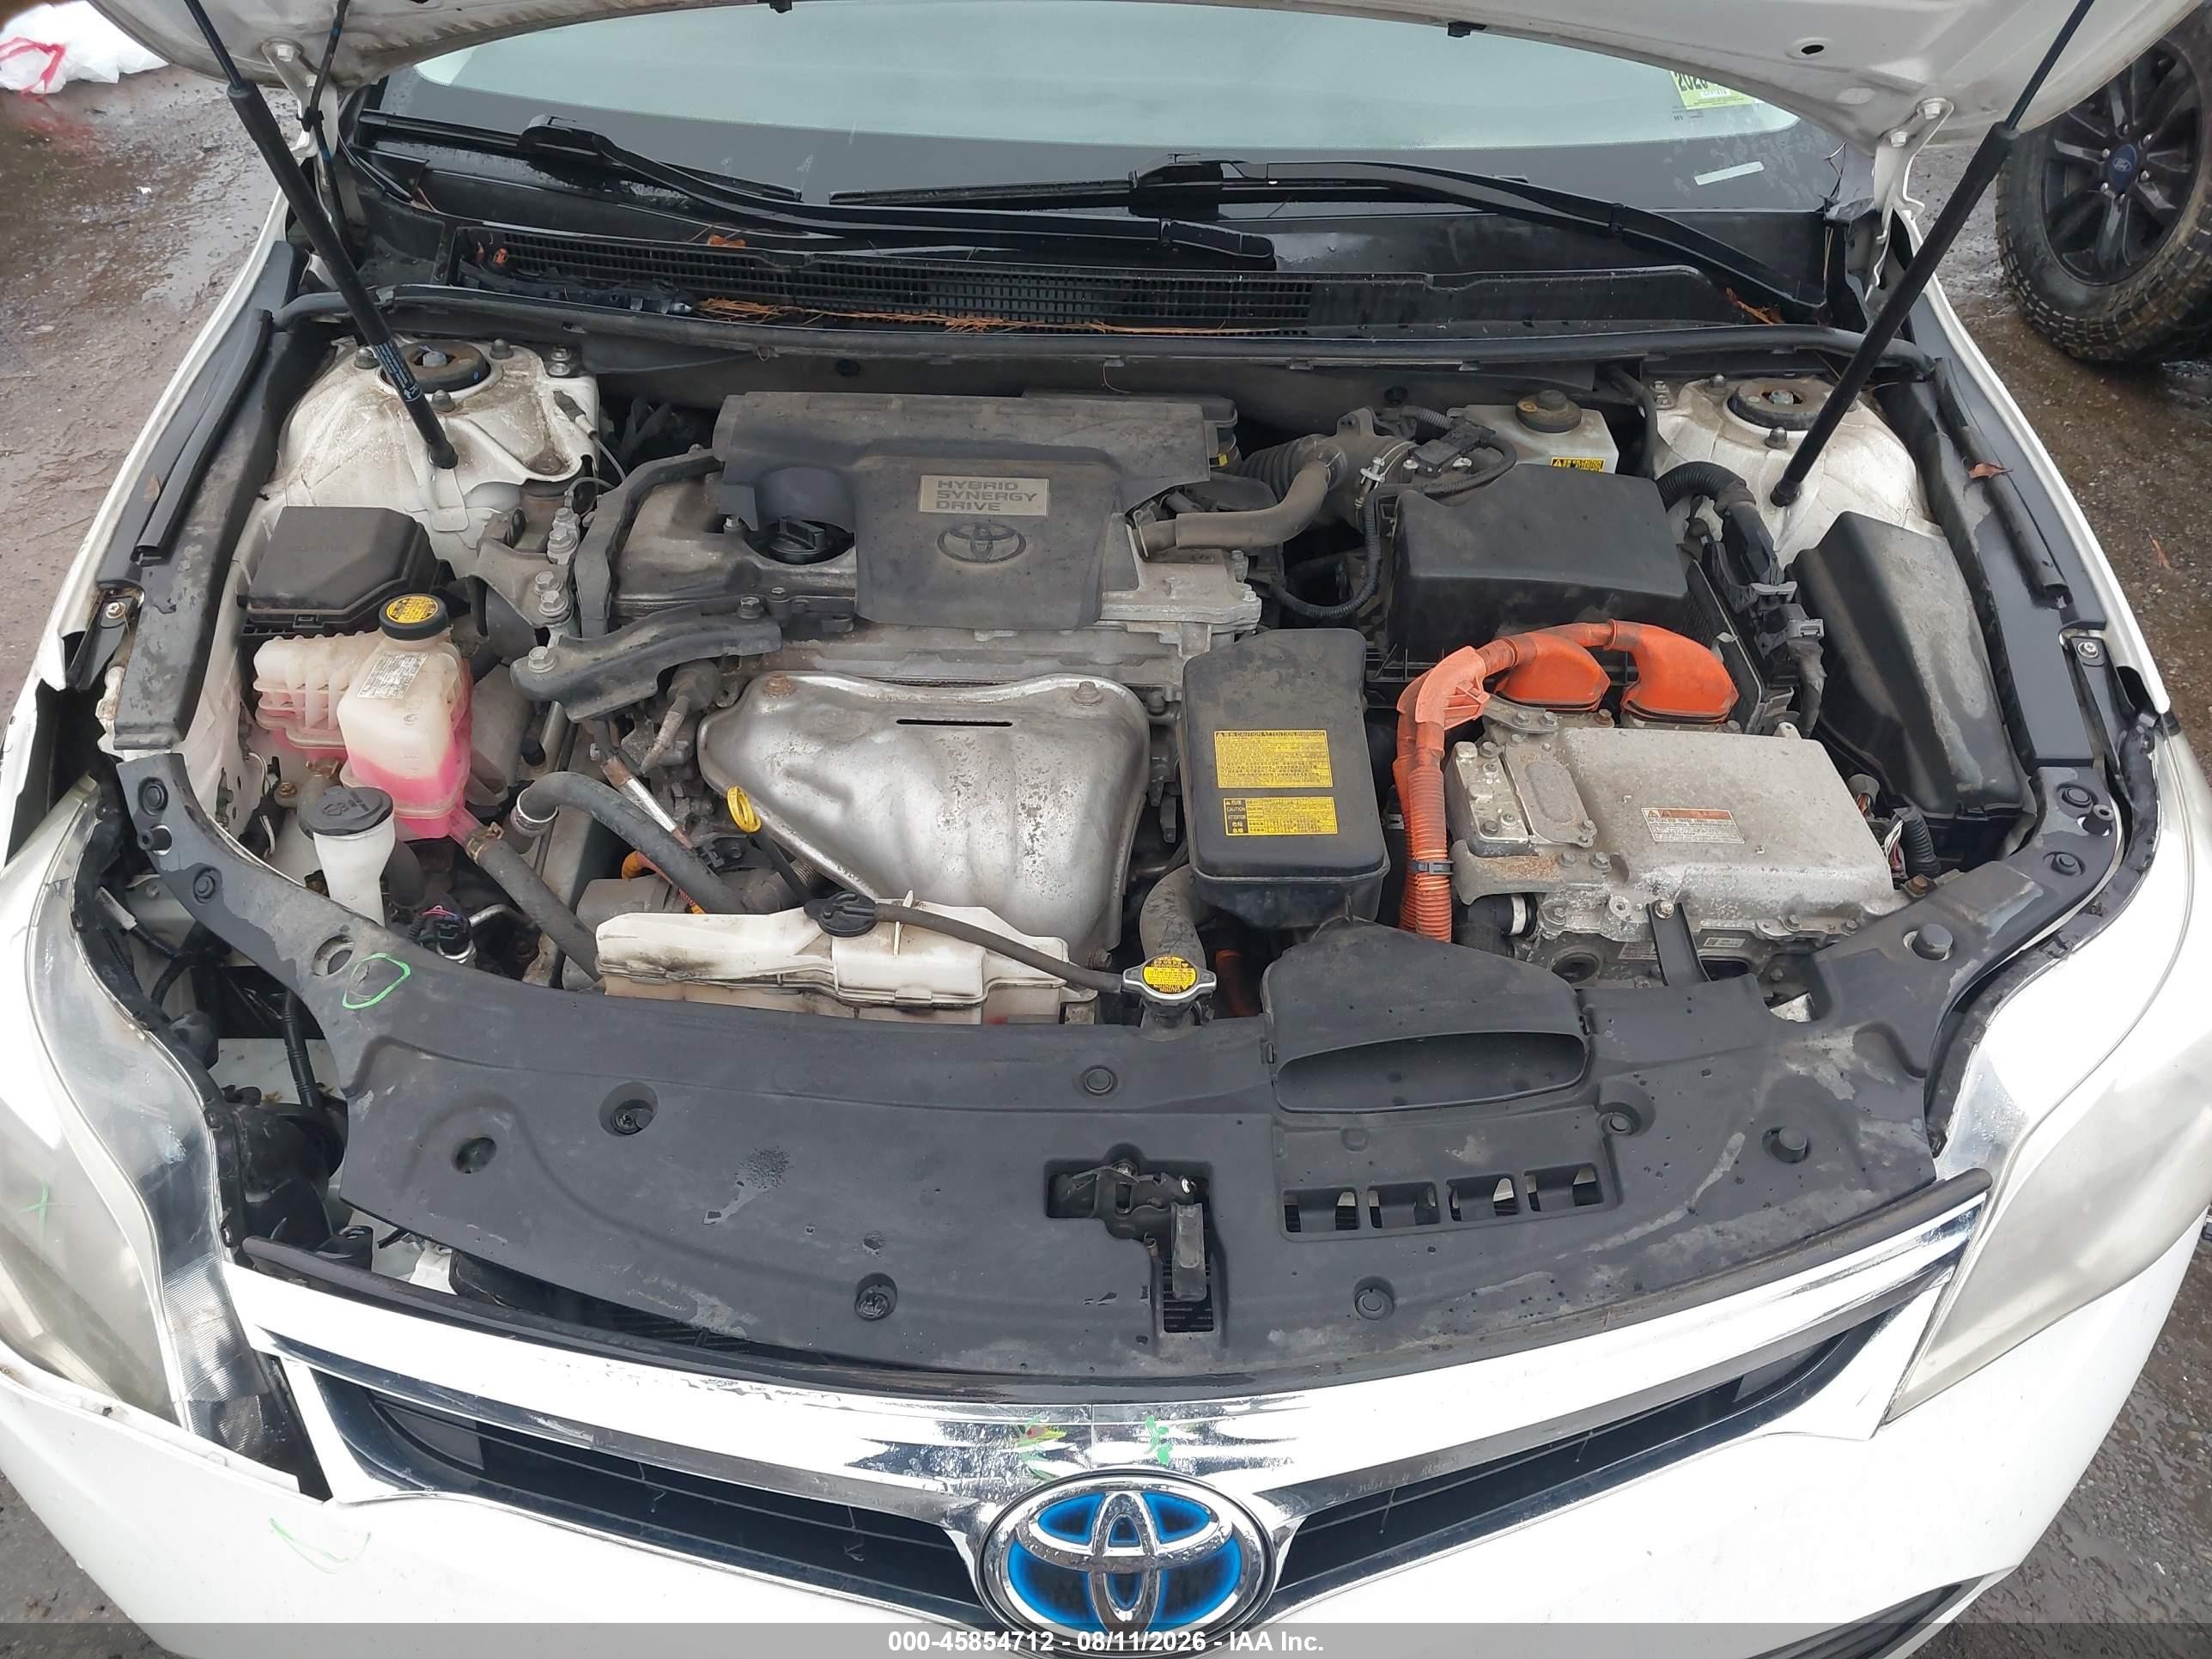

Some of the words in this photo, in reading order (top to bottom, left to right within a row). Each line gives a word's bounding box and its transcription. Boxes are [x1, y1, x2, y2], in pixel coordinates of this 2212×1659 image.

[937, 480, 1018, 490] HYBRID
[936, 490, 1037, 502] SYNERGY
[936, 501, 1002, 512] DRIVE
